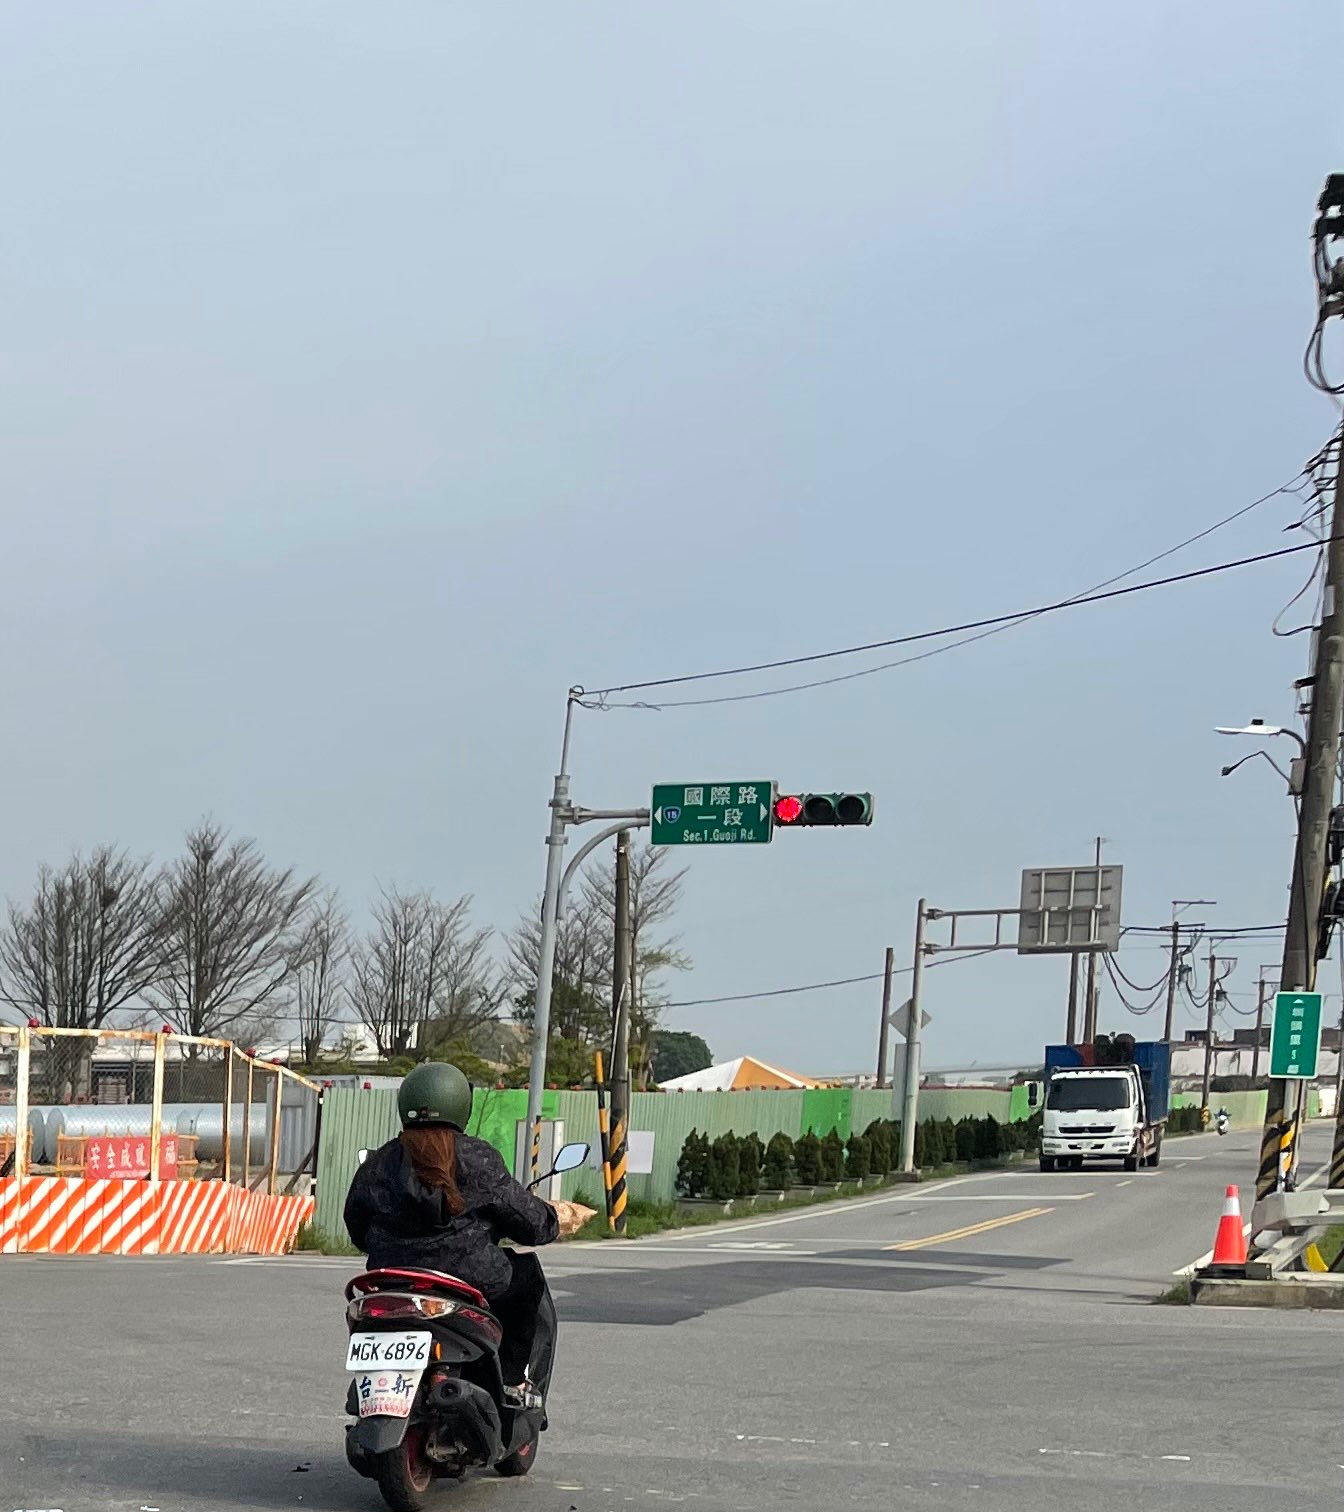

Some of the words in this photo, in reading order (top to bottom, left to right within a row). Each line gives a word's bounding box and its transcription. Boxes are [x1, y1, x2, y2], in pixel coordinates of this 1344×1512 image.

[684, 786, 758, 806] 國際路
[667, 811, 677, 819] 15
[697, 808, 743, 826] 一段
